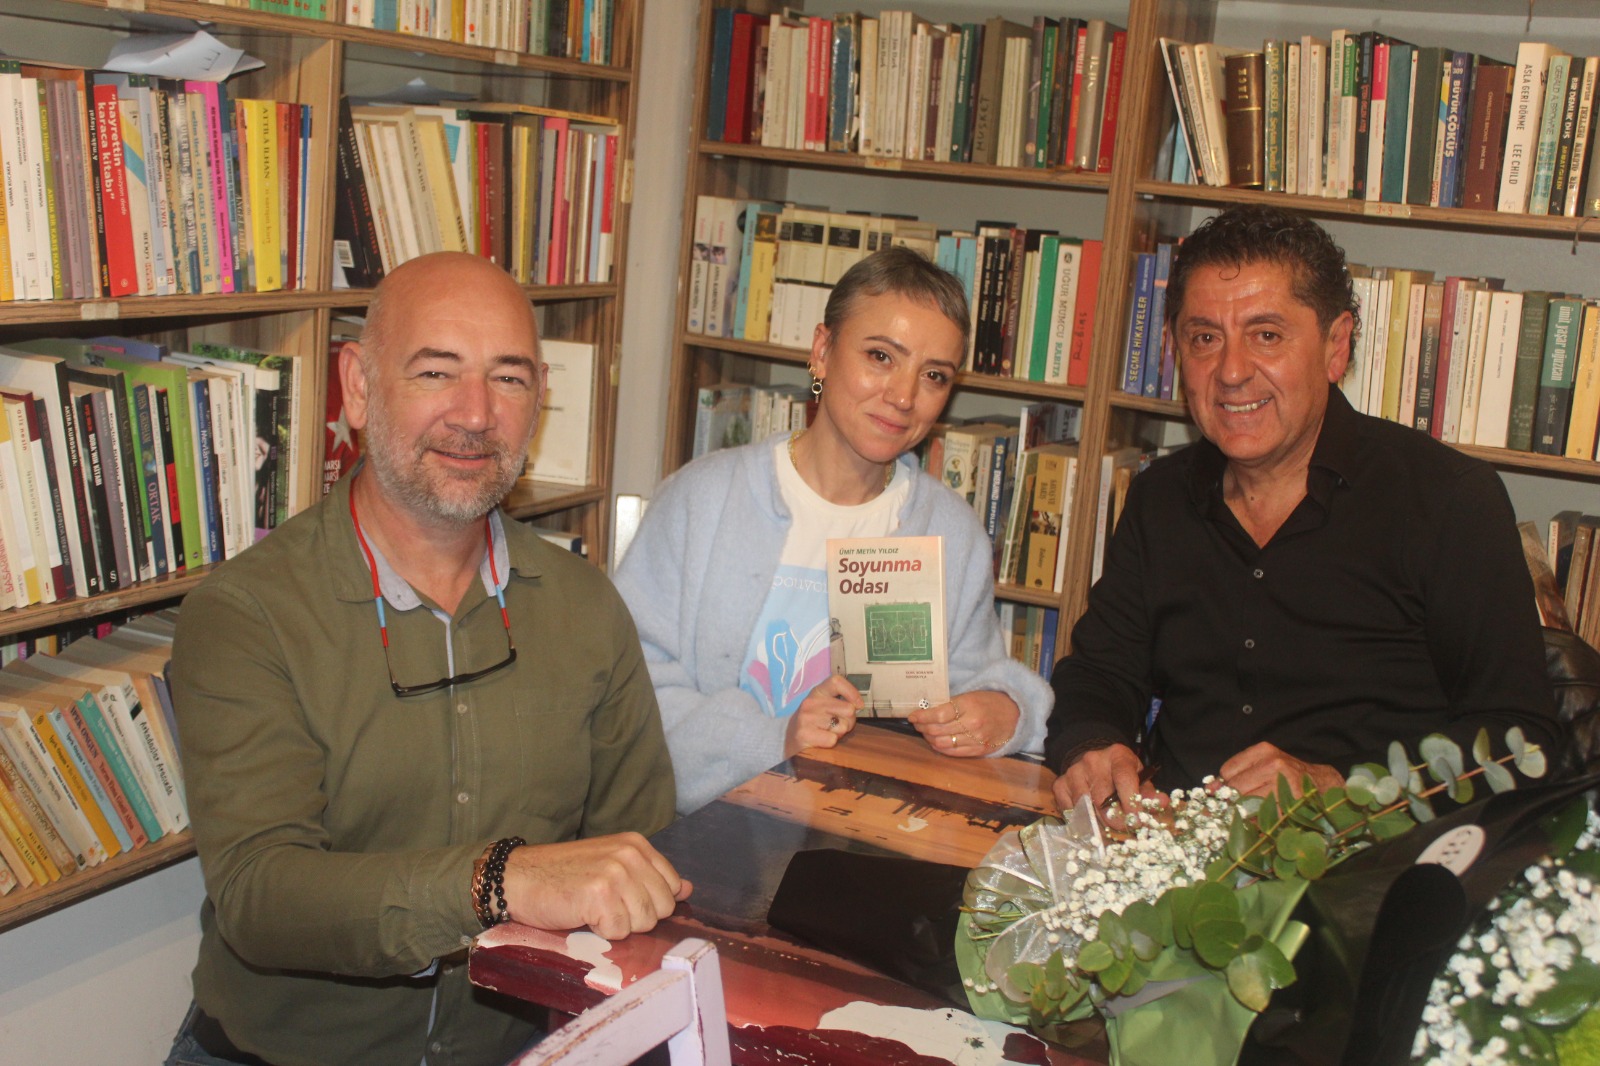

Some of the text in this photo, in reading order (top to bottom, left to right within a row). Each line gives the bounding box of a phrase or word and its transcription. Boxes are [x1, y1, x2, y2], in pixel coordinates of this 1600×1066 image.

[1270, 74, 1278, 113] CUSSLER
[1553, 65, 1563, 93] GERALD
[1443, 80, 1461, 158] BÜYÜK ÇÖKÜŞ
[1485, 92, 1493, 121] CHARLOTTE
[1546, 103, 1557, 135] BROWNE
[98, 102, 111, 149] karaca
[408, 123, 418, 158] KEMAL
[1508, 64, 1533, 185] ASLA GERİ DÖNME LEE CHILD
[196, 168, 204, 190] HER
[198, 193, 206, 219] GECE
[200, 223, 210, 267] BODRUM
[985, 252, 993, 270] Savaş
[998, 253, 1006, 270] Savaş
[980, 300, 989, 321] Tolstoy
[994, 302, 1002, 323] Tolstoy
[1052, 268, 1071, 378] UĞUR MUMCU RABITA
[1129, 297, 1147, 382] SEÇME HİKAYELER
[1551, 306, 1573, 381] ümit yaşar oğuzcan
[17, 409, 28, 451] aziz nesin
[136, 390, 151, 443] JOHN GRISHAM
[996, 444, 1004, 454] 10
[147, 482, 161, 524] ORTAK
[838, 557, 922, 577] Soyunma
[839, 578, 889, 594] Odası
[70, 706, 84, 728] İPEK
[78, 728, 98, 758] ONGUN
